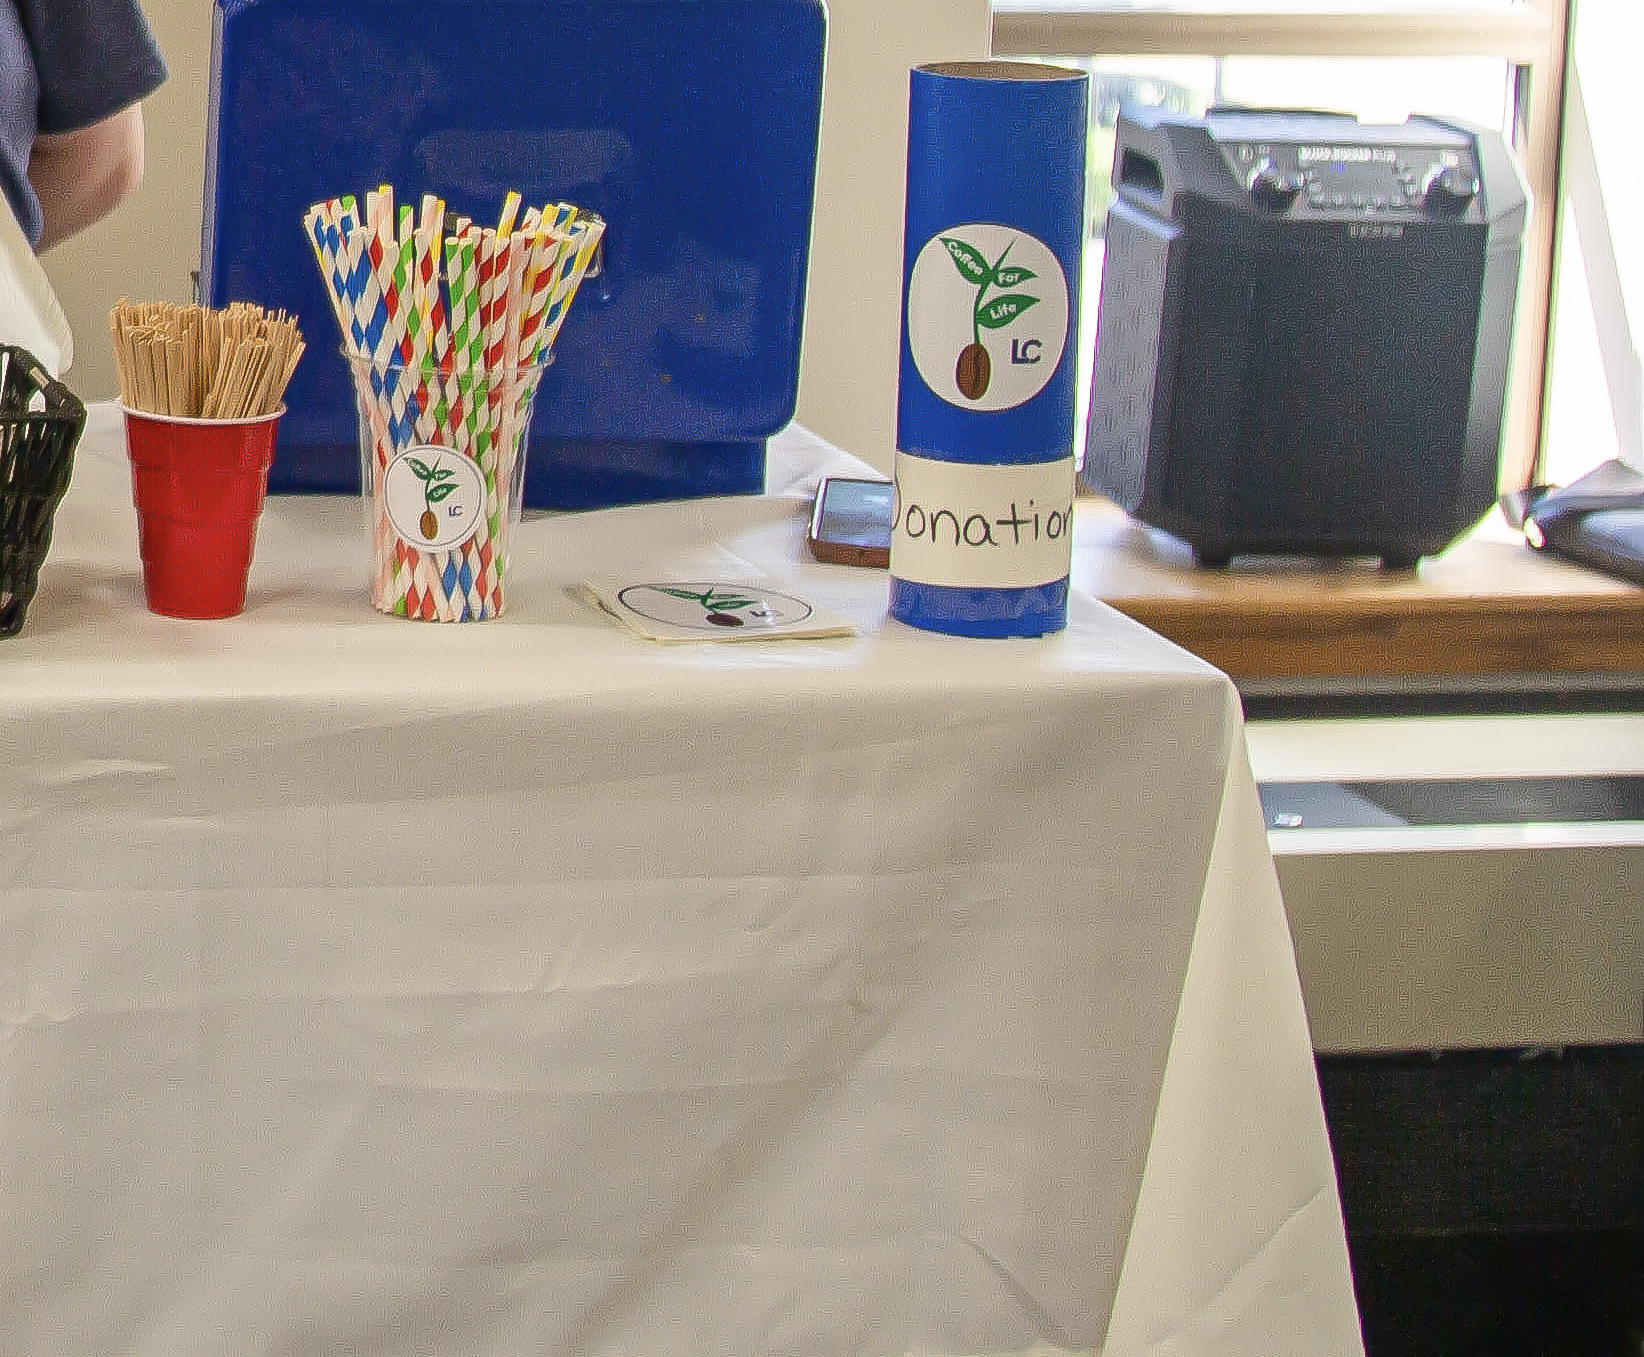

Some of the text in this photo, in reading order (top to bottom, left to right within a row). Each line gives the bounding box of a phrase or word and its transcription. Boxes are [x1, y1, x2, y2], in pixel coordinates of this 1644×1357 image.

[948, 241, 984, 275] Coffee
[997, 272, 1020, 284] For
[989, 303, 1017, 320] Life
[1011, 339, 1043, 365] LC
[448, 505, 464, 517] LC
